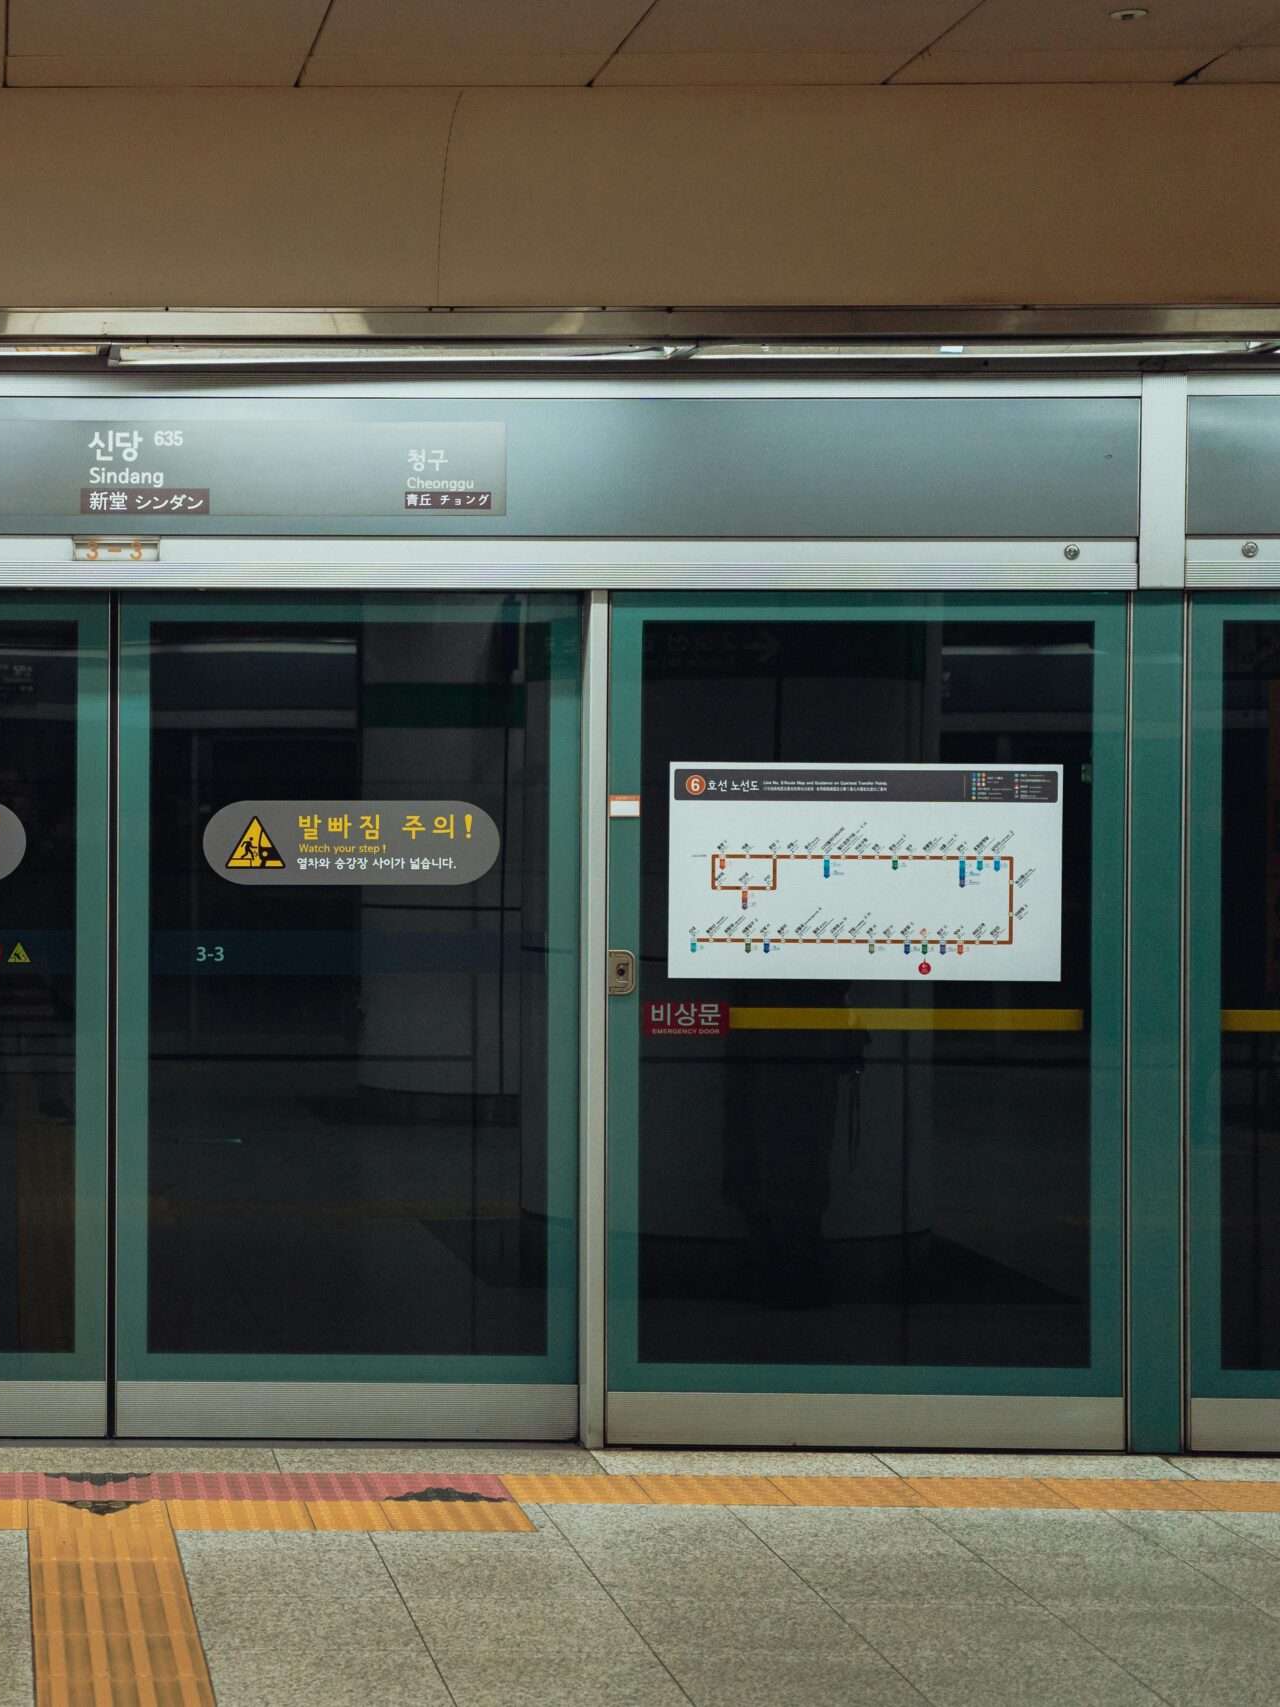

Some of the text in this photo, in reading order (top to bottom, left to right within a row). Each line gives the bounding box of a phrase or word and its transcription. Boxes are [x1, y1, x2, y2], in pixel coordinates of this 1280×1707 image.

[87, 429, 184, 462] 신당 635
[407, 448, 449, 472] 청구
[89, 466, 164, 488] Sindang
[406, 476, 475, 492] Cheonggu
[89, 491, 204, 511] 新堂 シンダン
[440, 494, 490, 506] チョング
[690, 778, 760, 792] 6 호선 노선도
[298, 814, 474, 840] 발빠짐 주의!
[299, 843, 331, 853] Watch
[334, 845, 356, 856] your
[296, 857, 330, 870] 열차와
[335, 857, 369, 870] 승강장
[372, 857, 406, 870] 사이가
[196, 946, 225, 962] 3-3
[651, 1002, 721, 1027] 비상문
